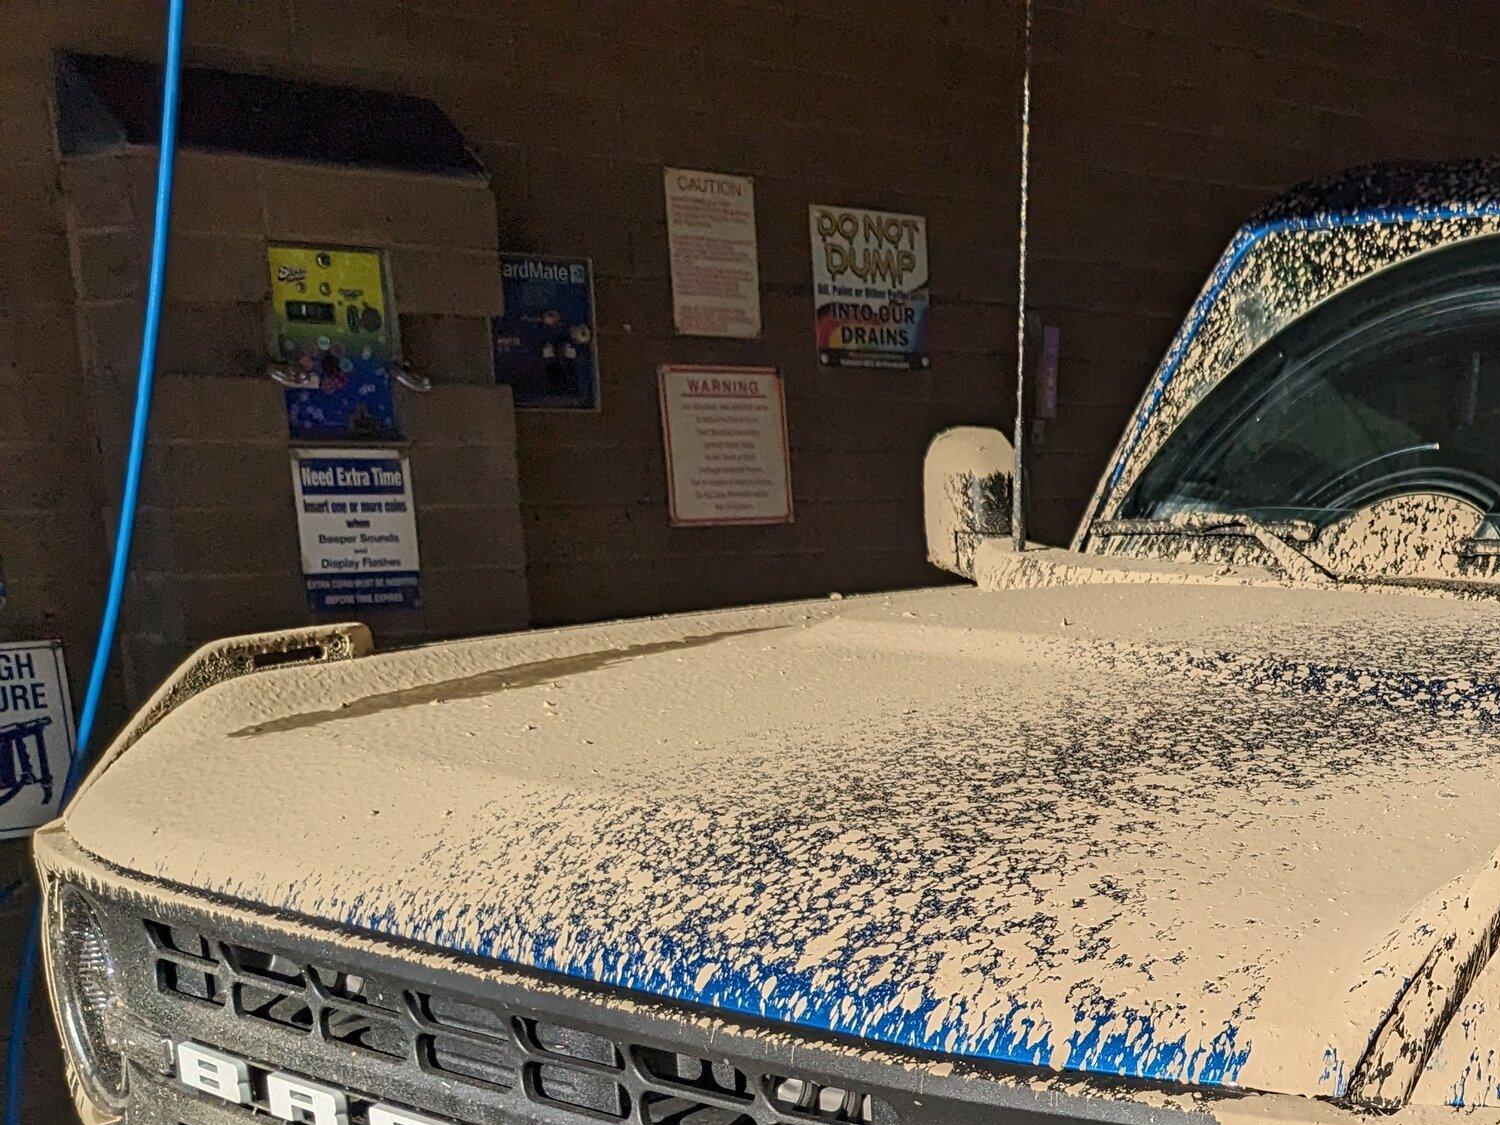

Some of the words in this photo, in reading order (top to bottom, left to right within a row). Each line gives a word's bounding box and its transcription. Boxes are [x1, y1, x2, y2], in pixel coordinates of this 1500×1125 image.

[677, 175, 742, 197] CAUTION
[816, 210, 859, 245] DO
[864, 213, 920, 250] NOT
[502, 259, 569, 281] ardMate
[823, 243, 916, 288] DUMP
[832, 302, 873, 321] INTO
[879, 305, 915, 325] OUR
[841, 325, 910, 347] DRAINS
[687, 379, 760, 395] WARNING
[301, 466, 334, 487] Need
[336, 466, 371, 487] Extra
[371, 466, 403, 486] Time
[303, 499, 330, 513] Insert
[332, 501, 347, 513] one
[349, 501, 358, 513] or
[361, 501, 383, 513] more
[346, 518, 370, 528] when
[319, 534, 357, 545] Beeper
[360, 532, 400, 543] Sounds
[321, 558, 359, 570] Display
[362, 557, 401, 567] Flashes
